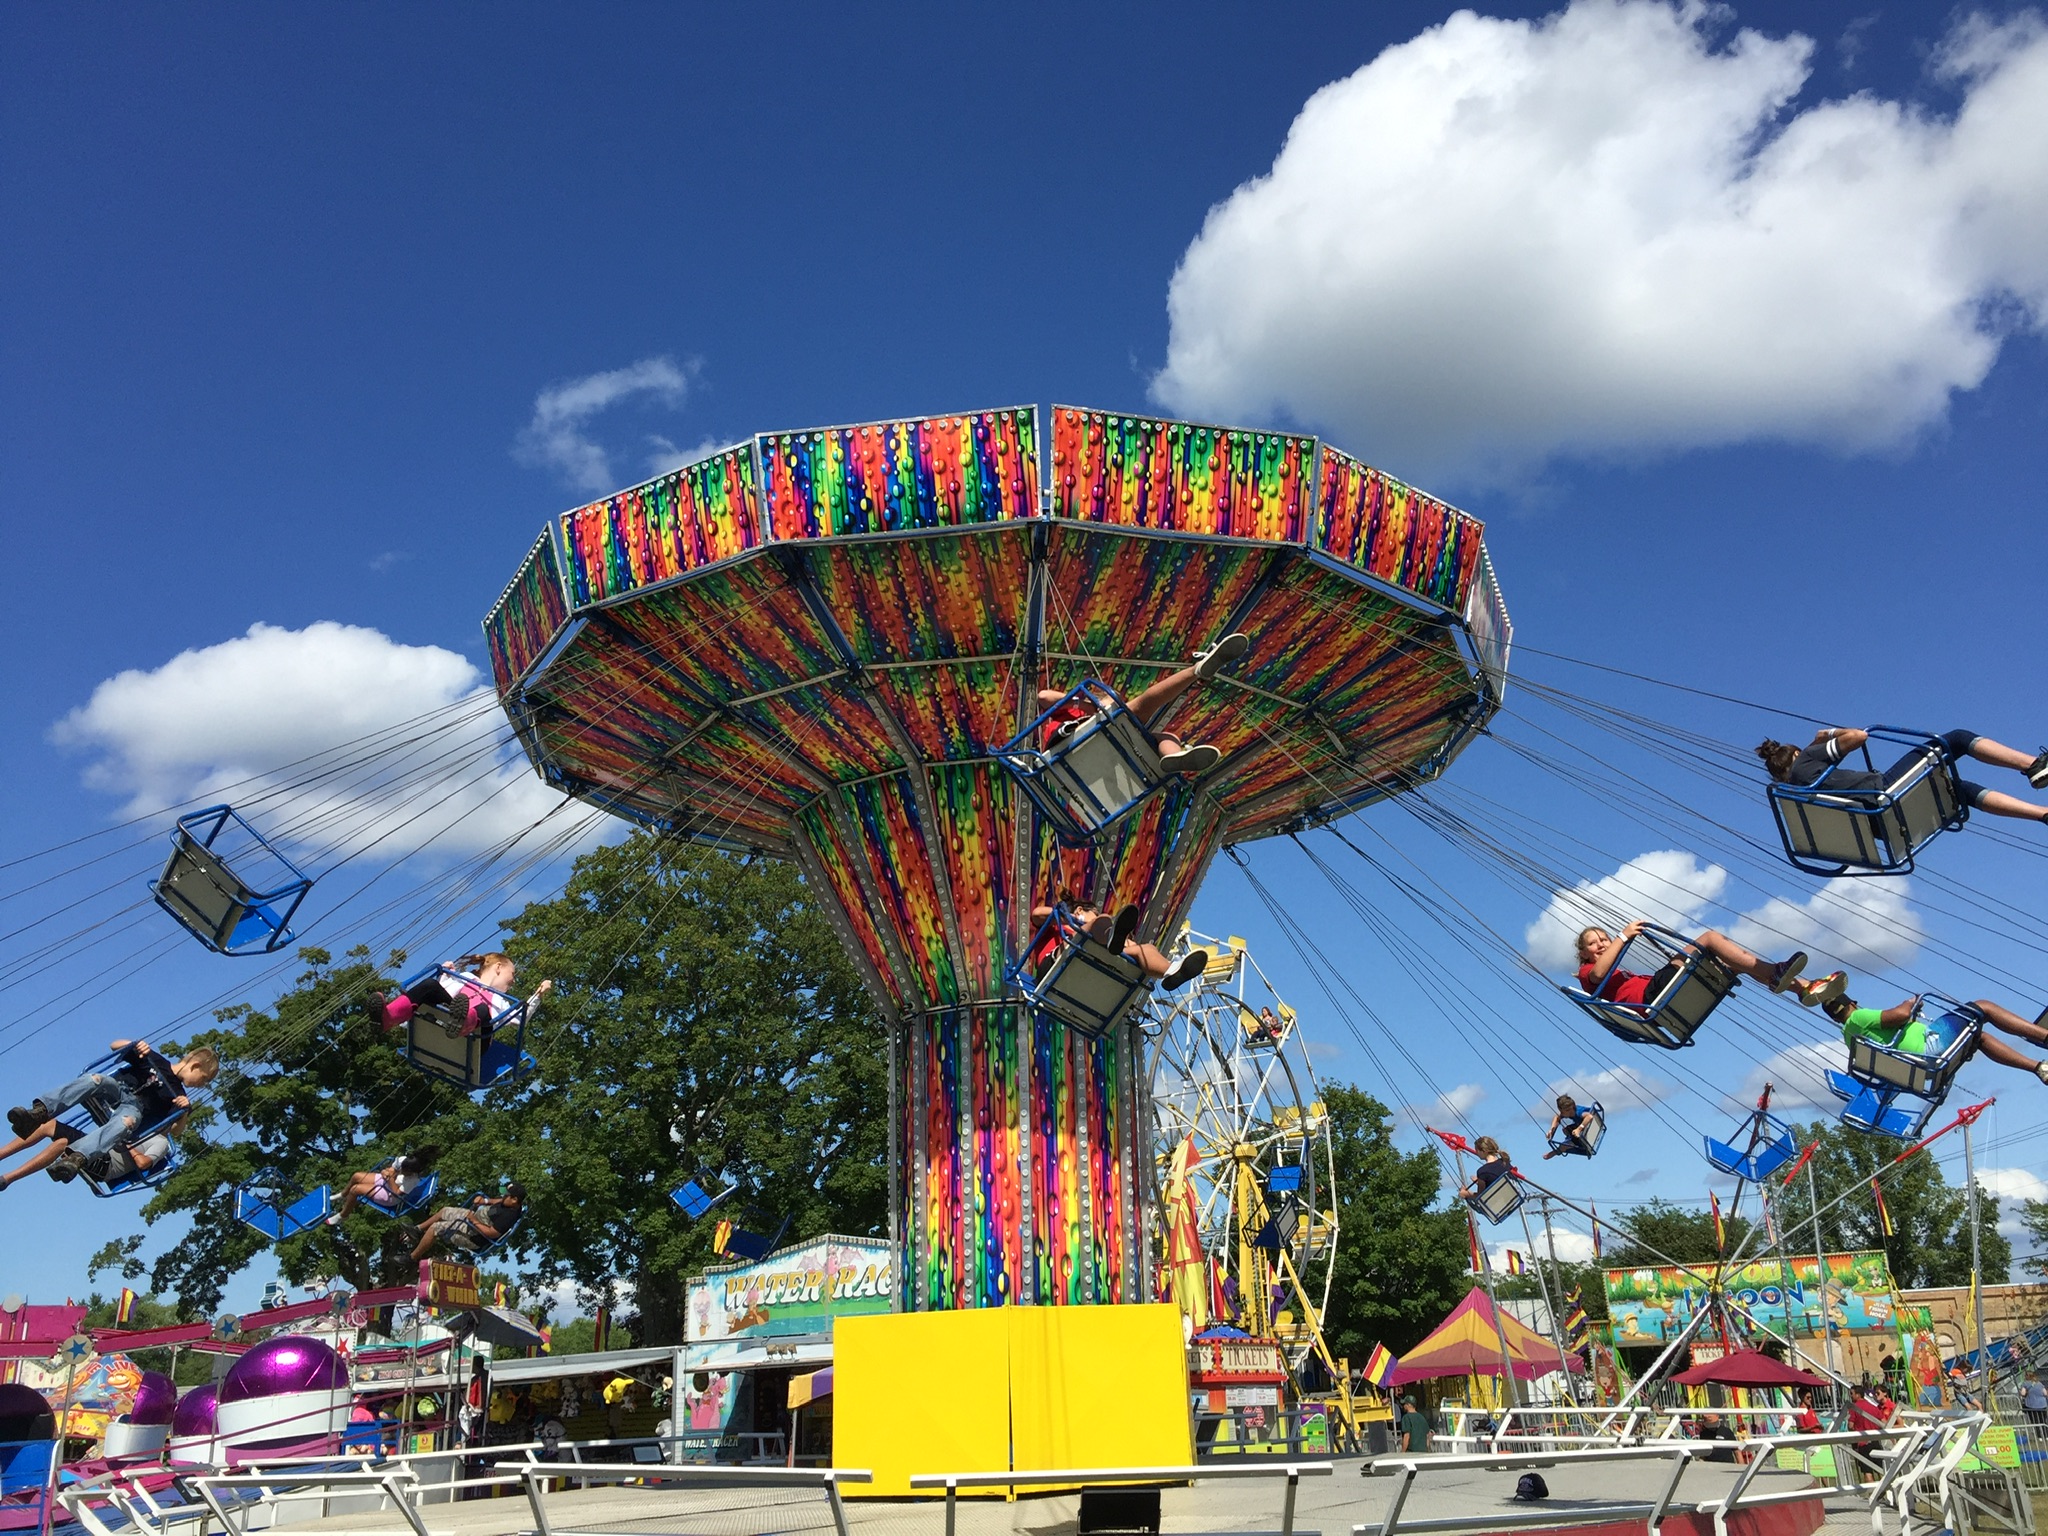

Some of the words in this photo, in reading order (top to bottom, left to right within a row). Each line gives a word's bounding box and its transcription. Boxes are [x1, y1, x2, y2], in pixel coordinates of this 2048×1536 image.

[447, 1286, 480, 1305] WHIRL
[725, 1270, 825, 1311] WATER
[1227, 1347, 1269, 1366] TICKETS
[104, 1360, 140, 1374] LIVE
